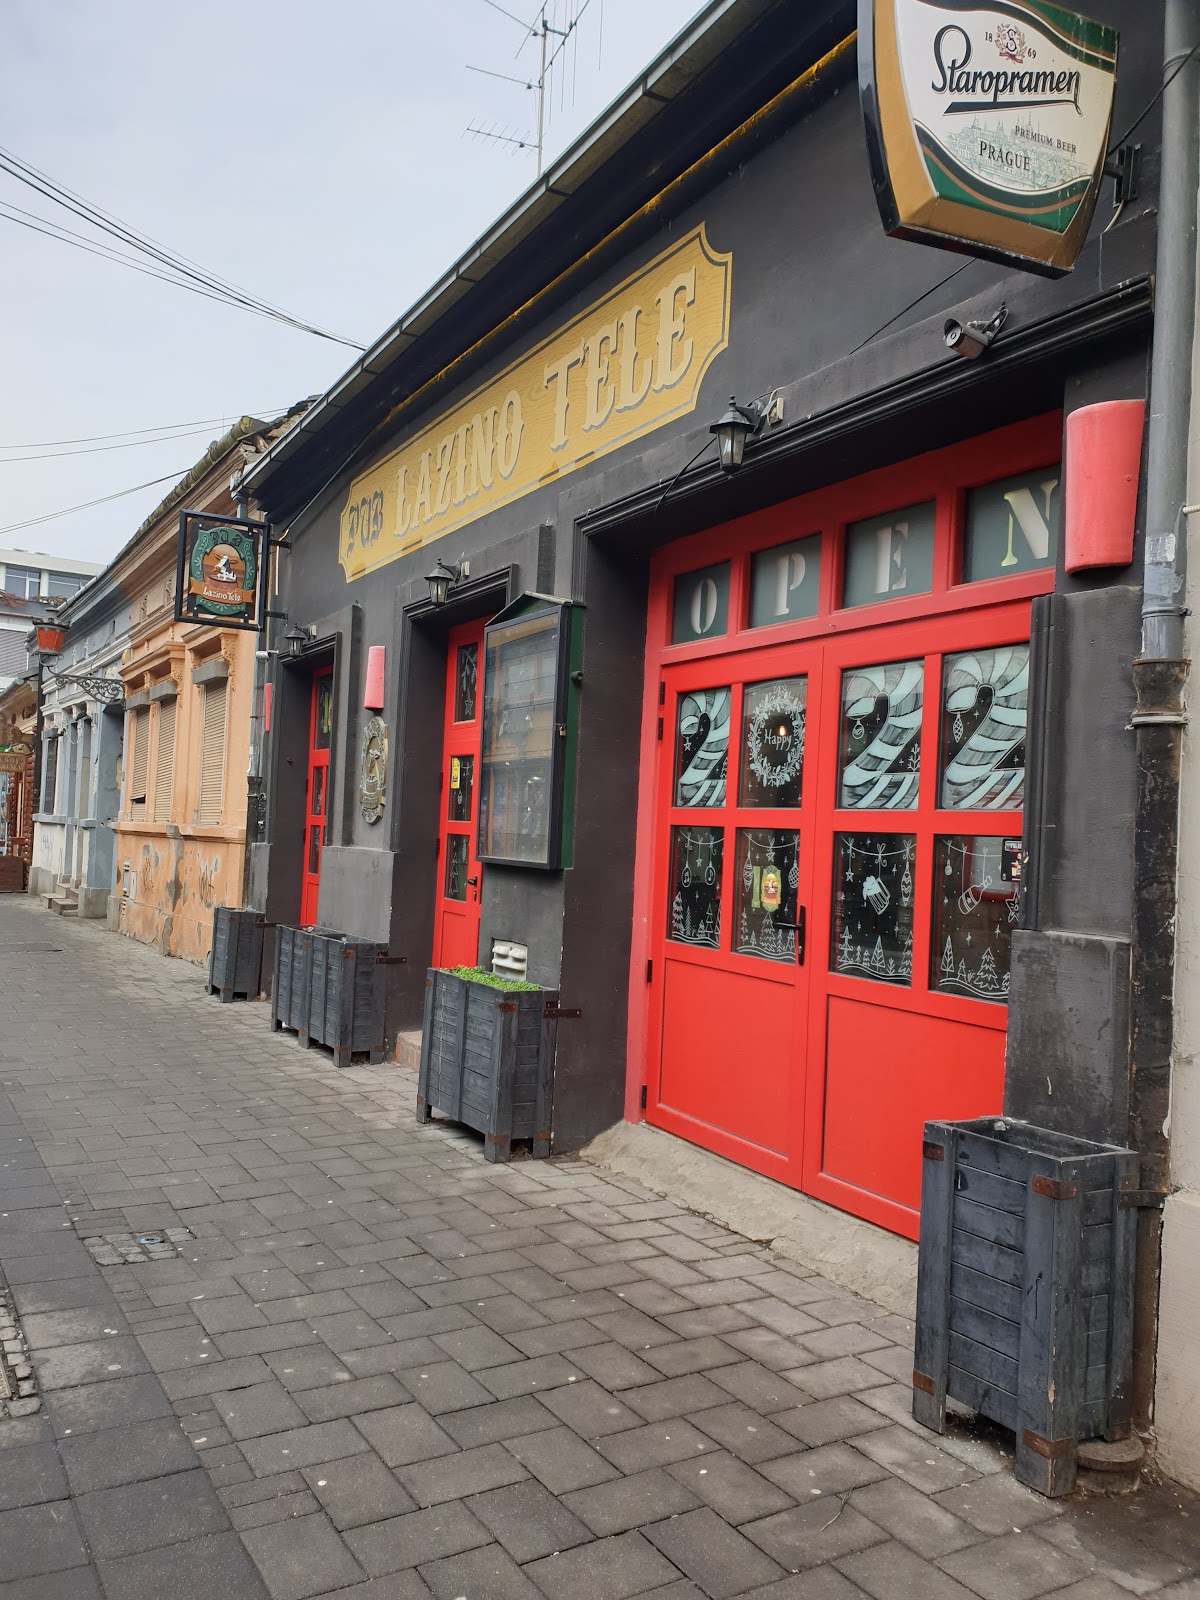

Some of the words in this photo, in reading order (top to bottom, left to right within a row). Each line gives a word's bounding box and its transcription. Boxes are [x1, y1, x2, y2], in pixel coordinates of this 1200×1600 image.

[984, 31, 993, 43] 18
[1027, 48, 1037, 59] 69
[931, 24, 1082, 116] Staropramen
[1015, 125, 1053, 147] PREMIUM
[1056, 138, 1077, 154] BEER
[979, 140, 1030, 171] PRAGUE
[394, 390, 525, 537] LAZINO
[544, 265, 697, 453] TELE
[764, 728, 792, 751] Happy
